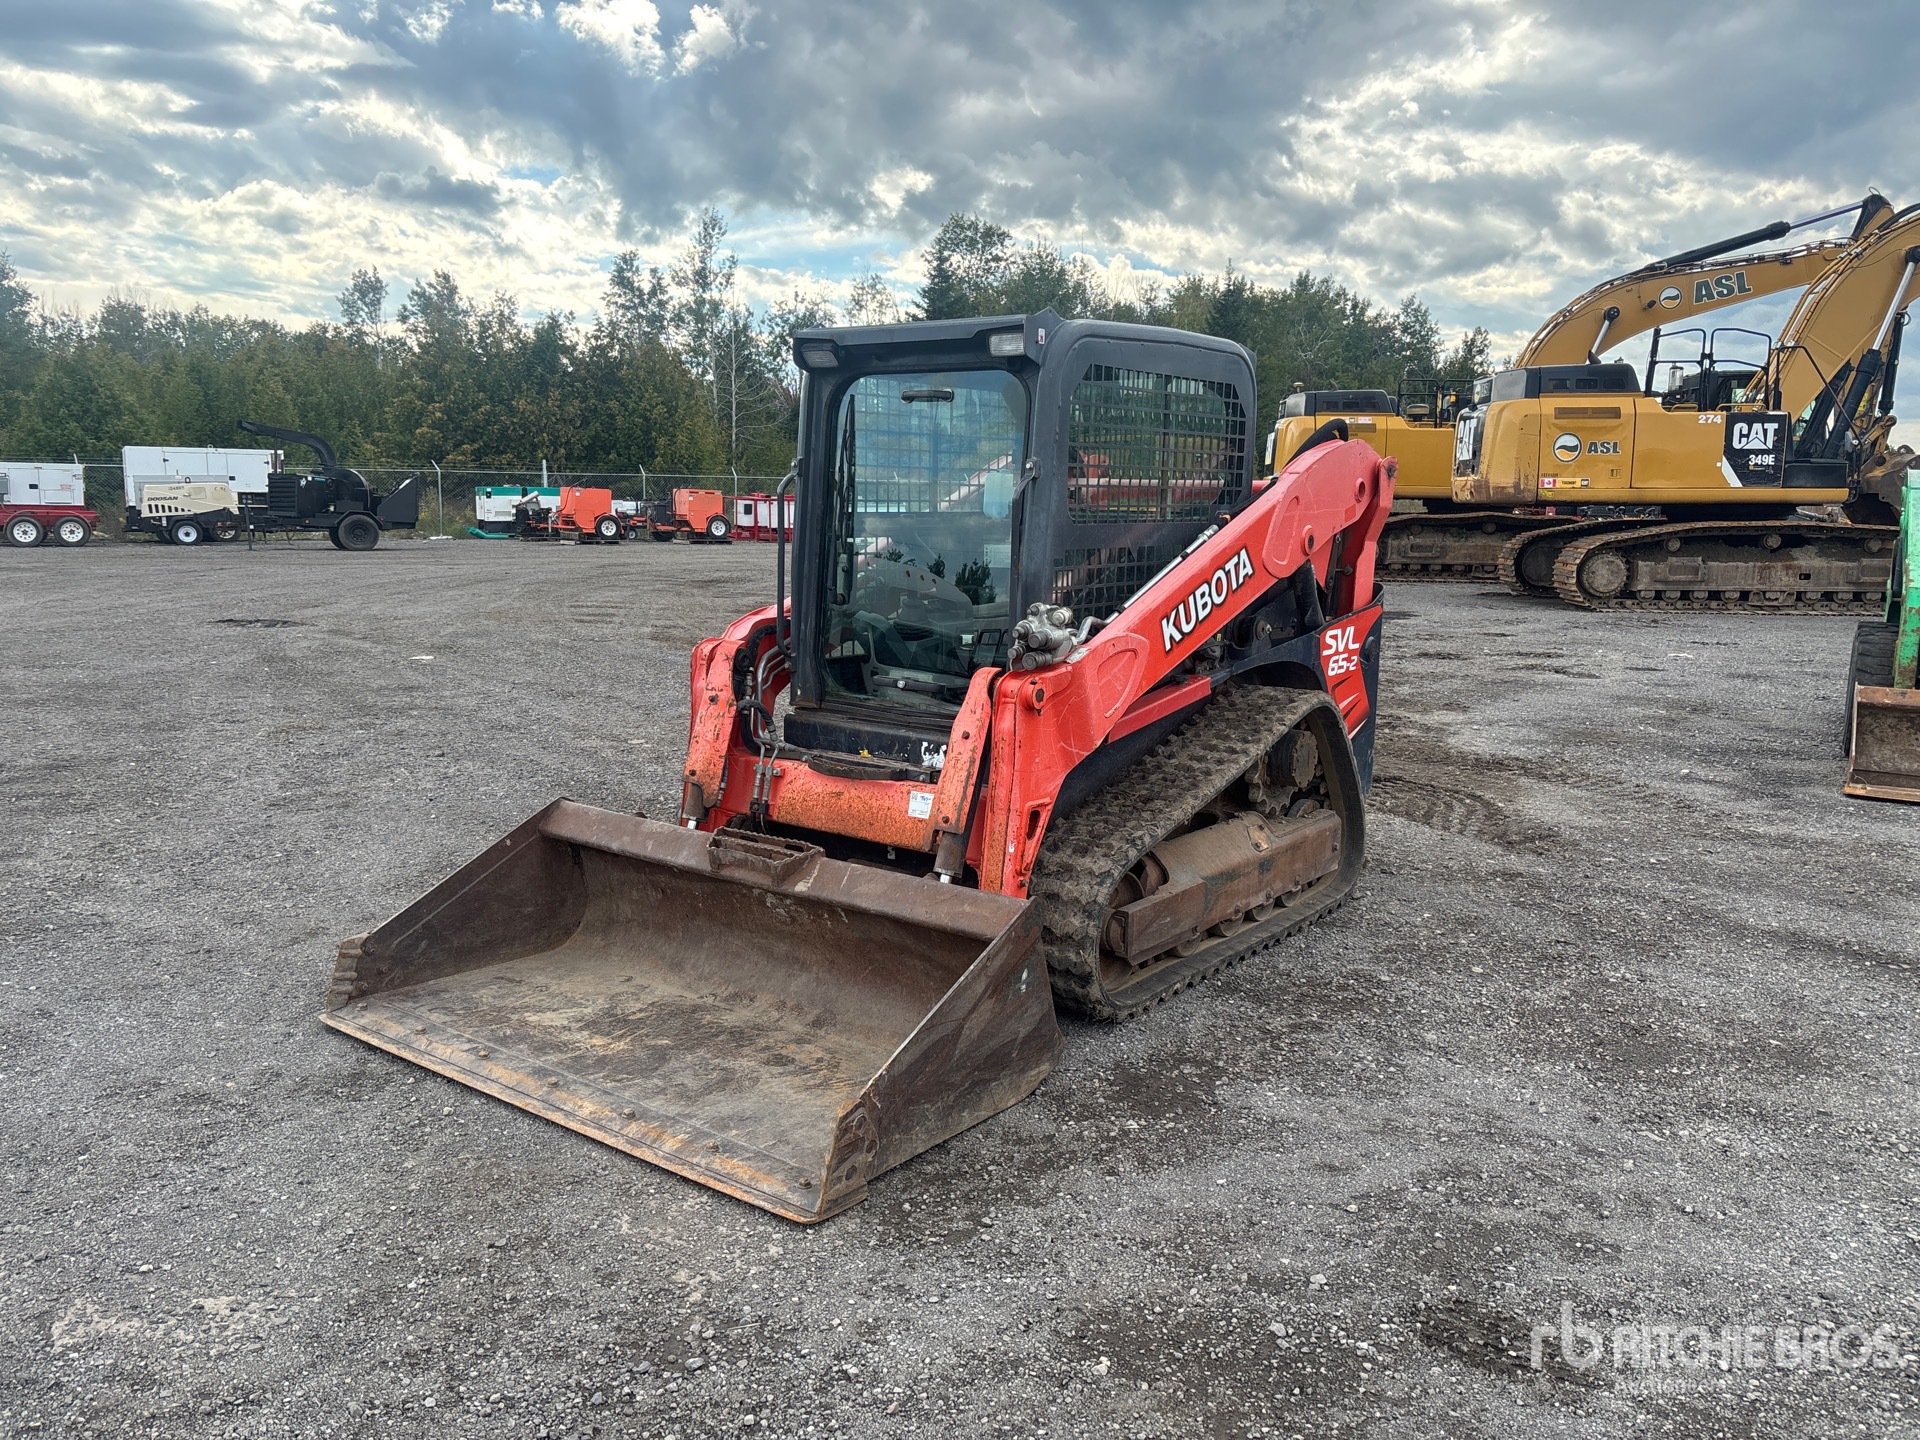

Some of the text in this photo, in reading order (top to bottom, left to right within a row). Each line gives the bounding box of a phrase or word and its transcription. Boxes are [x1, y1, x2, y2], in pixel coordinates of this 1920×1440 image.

[1693, 270, 1753, 305] ASL
[1698, 414, 1723, 425] 274
[1456, 418, 1478, 461] CAT
[1586, 441, 1622, 456] ASL
[1732, 422, 1779, 450] CAT
[1748, 454, 1776, 466] 349E
[1160, 546, 1255, 652] KUBOTA
[1322, 625, 1361, 656] SVL
[1328, 653, 1358, 677] 65-2
